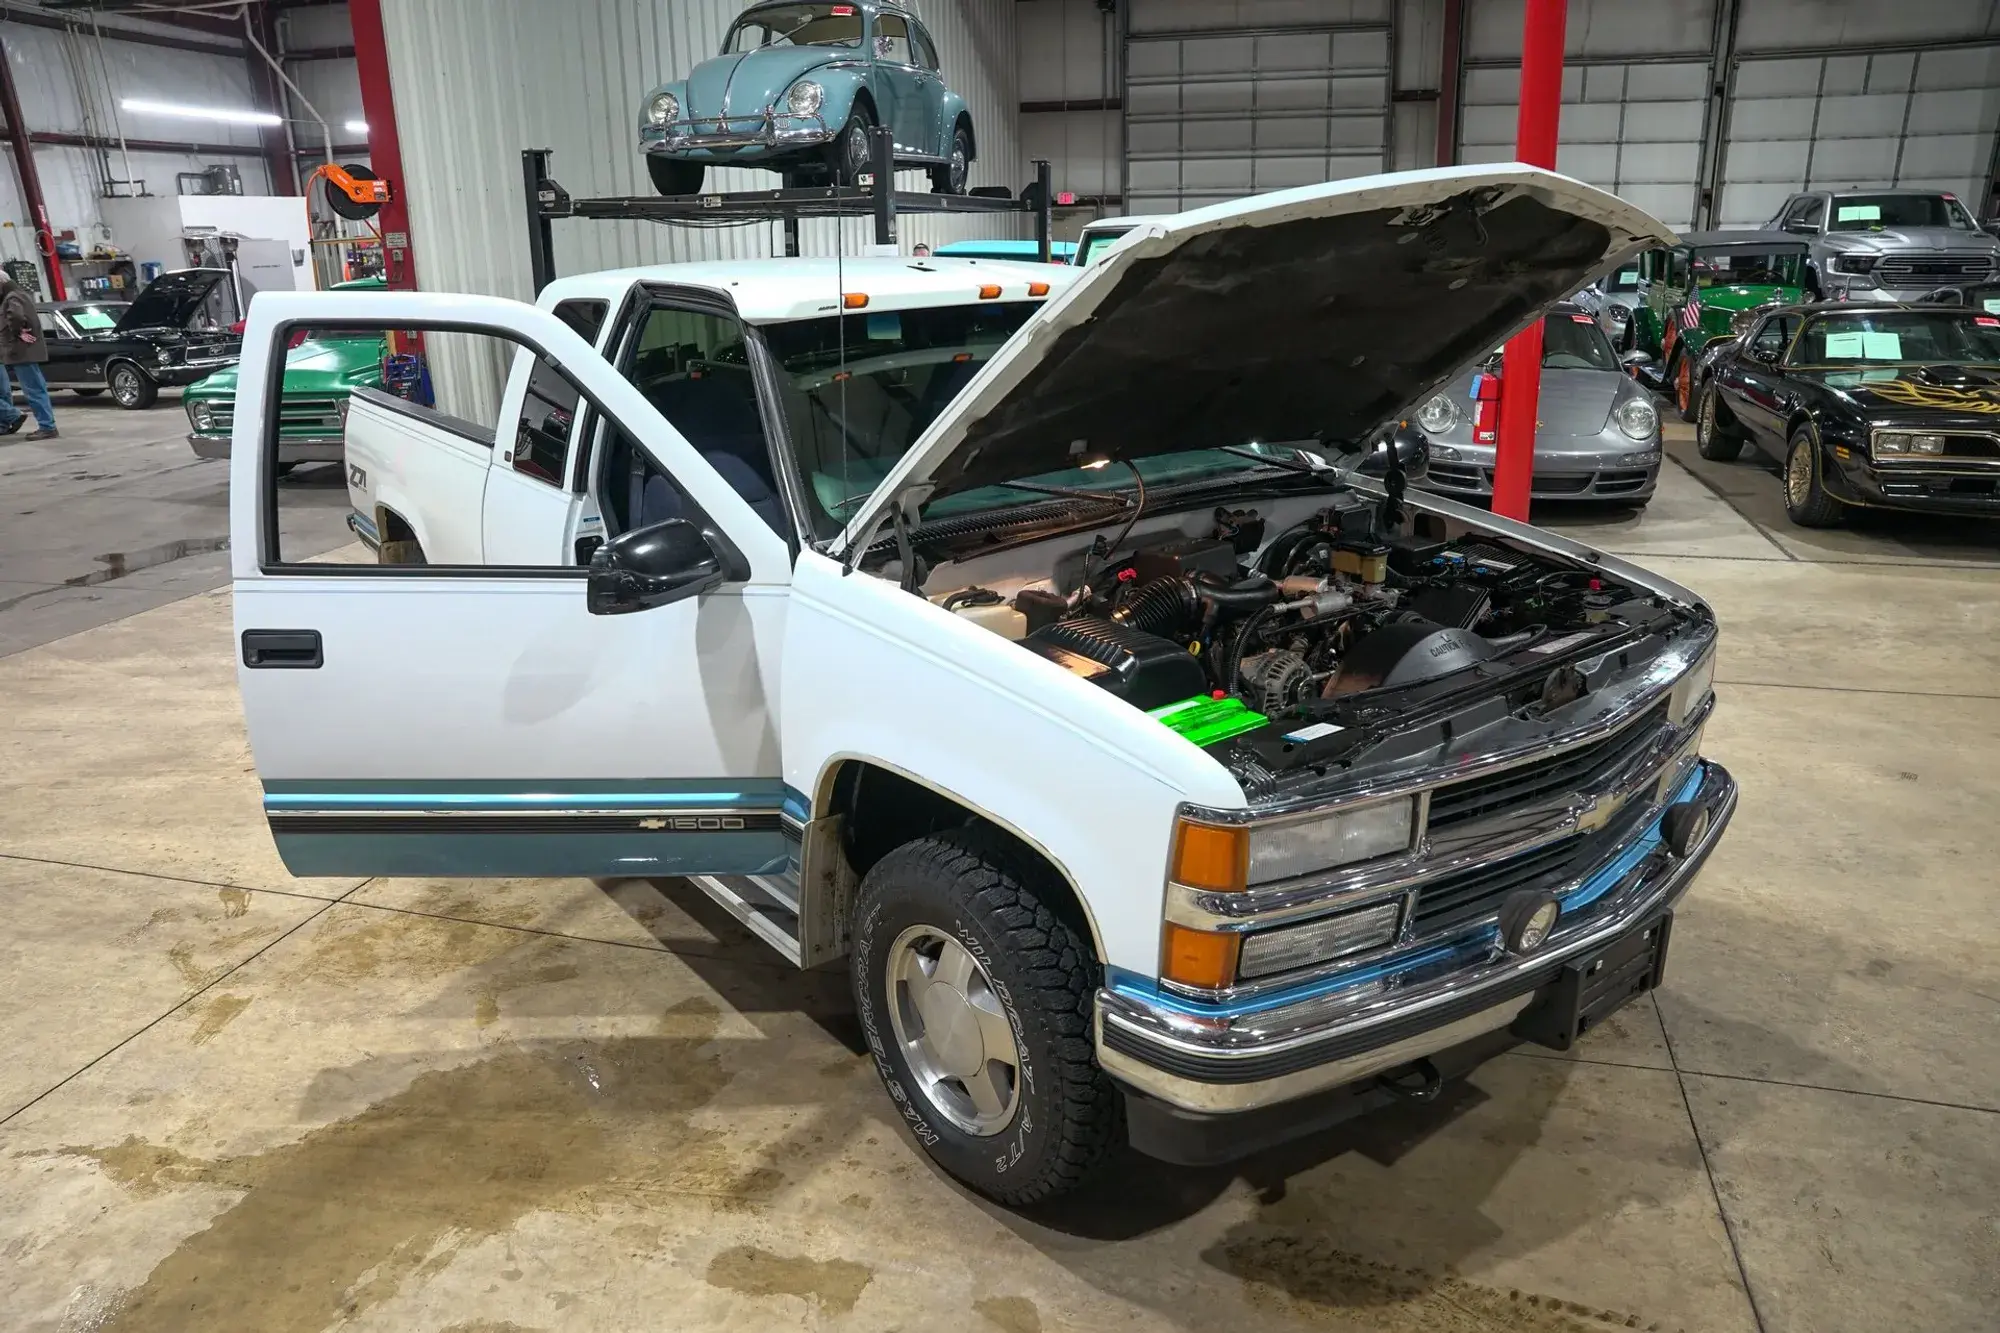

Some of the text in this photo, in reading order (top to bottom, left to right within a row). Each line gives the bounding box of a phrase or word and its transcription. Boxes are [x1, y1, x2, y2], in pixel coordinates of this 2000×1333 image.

[349, 462, 367, 488] Z71
[1430, 640, 1461, 658] CAUTION
[667, 817, 745, 830] 1500
[955, 919, 1036, 1095] WILDCAT
[856, 902, 940, 1147] MASTERCRAFT
